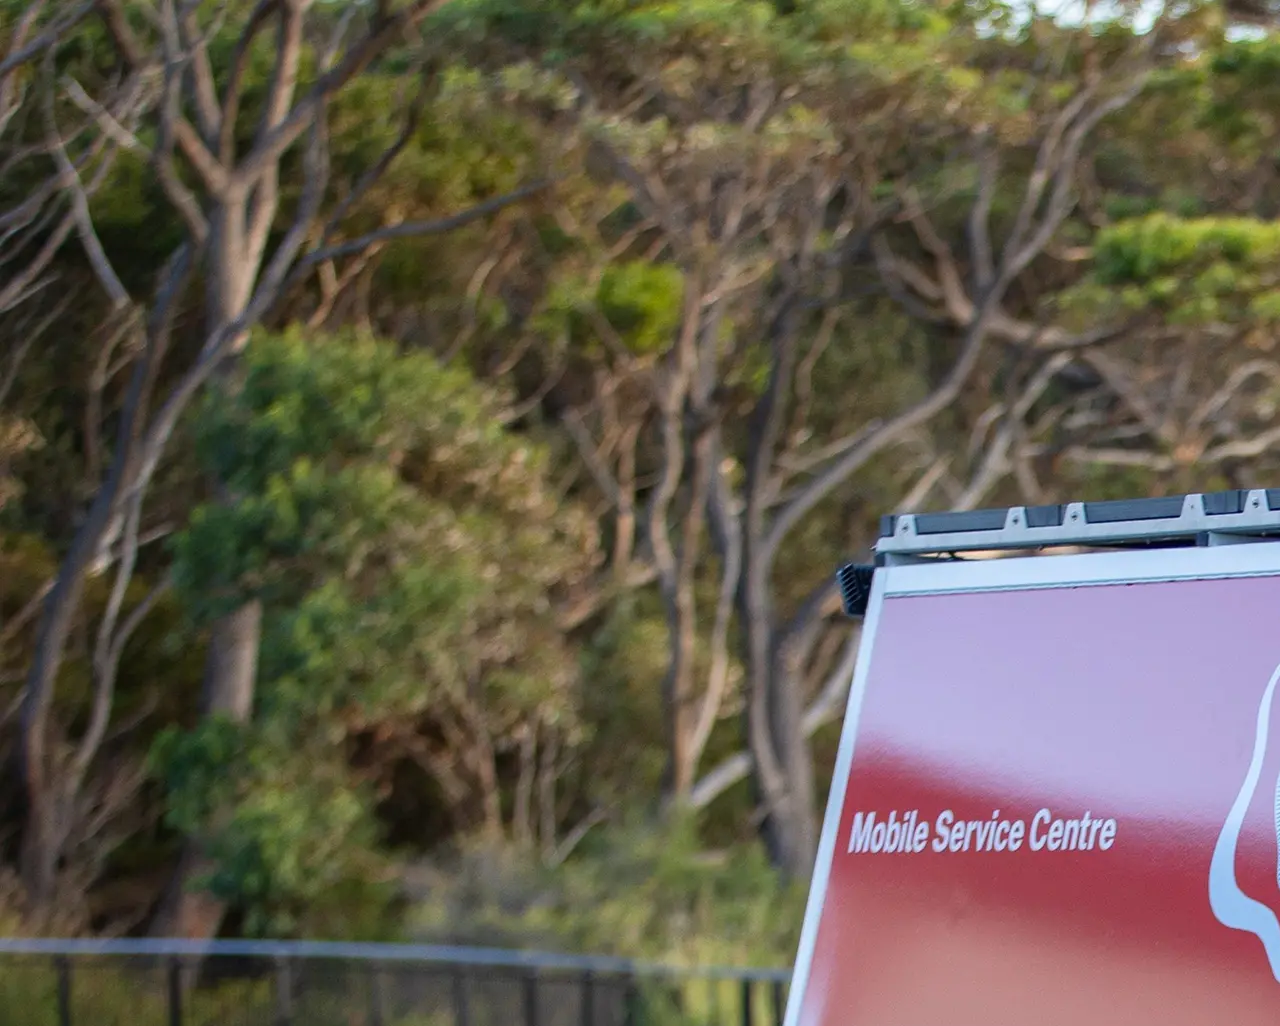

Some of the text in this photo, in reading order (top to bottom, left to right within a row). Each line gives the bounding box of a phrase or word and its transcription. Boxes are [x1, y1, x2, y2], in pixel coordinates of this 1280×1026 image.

[848, 808, 1117, 854] Mobile Service Centre
